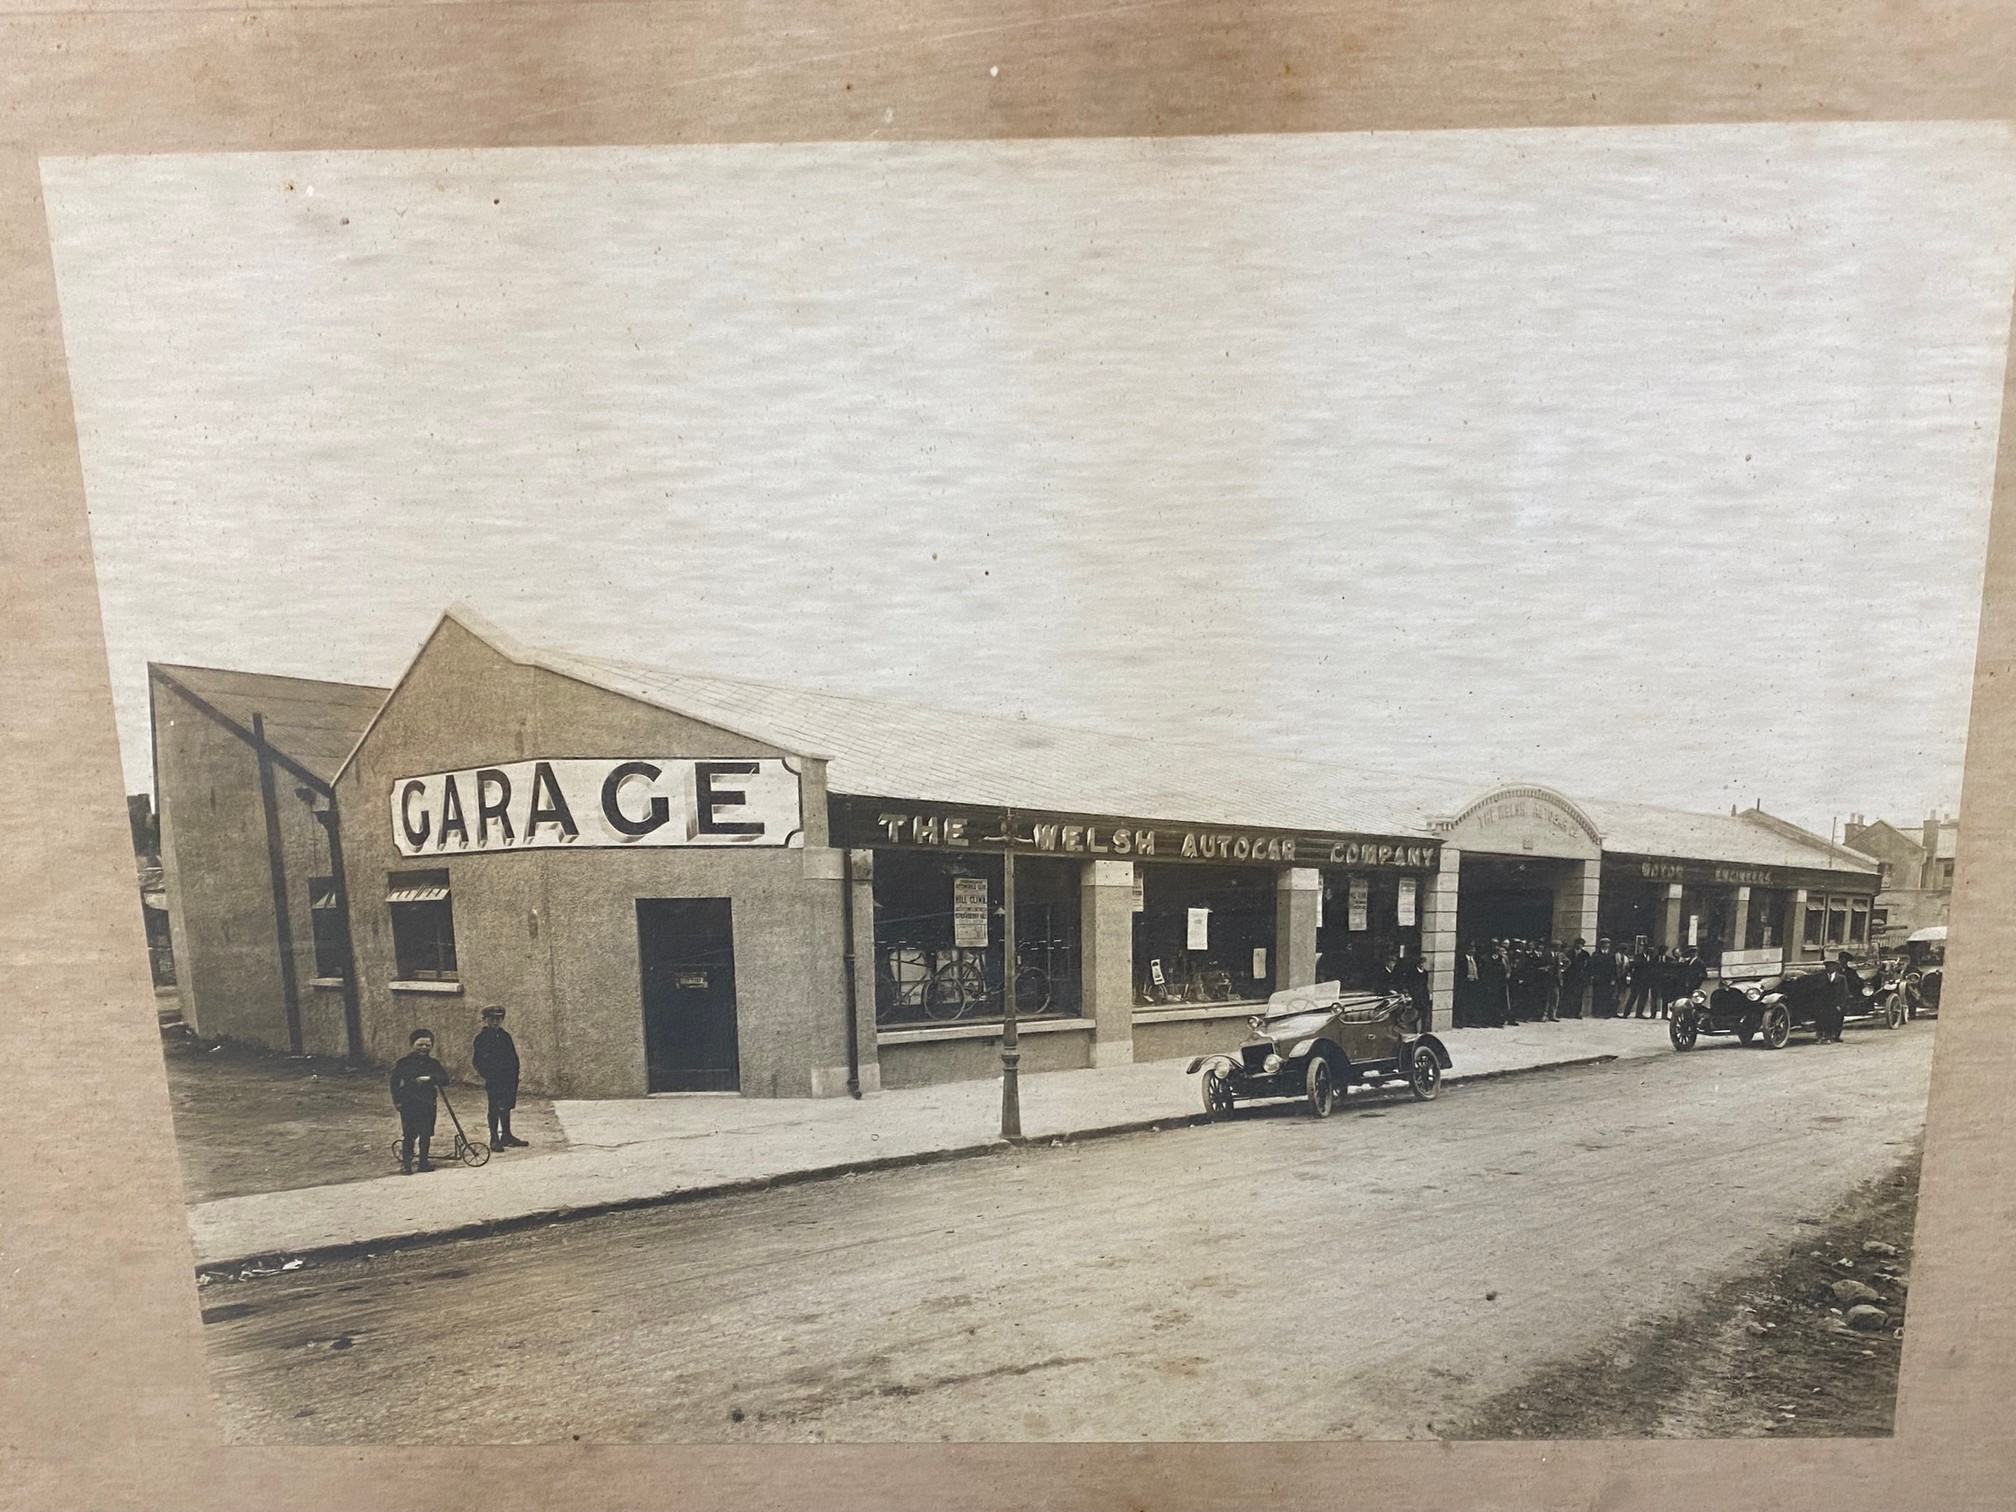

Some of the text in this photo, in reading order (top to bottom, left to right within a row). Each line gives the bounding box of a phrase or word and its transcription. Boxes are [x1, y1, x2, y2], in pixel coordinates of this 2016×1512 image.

[400, 761, 766, 852] GARAGE
[878, 813, 1435, 867] THE WELSH AUTOCAR COMPANY
